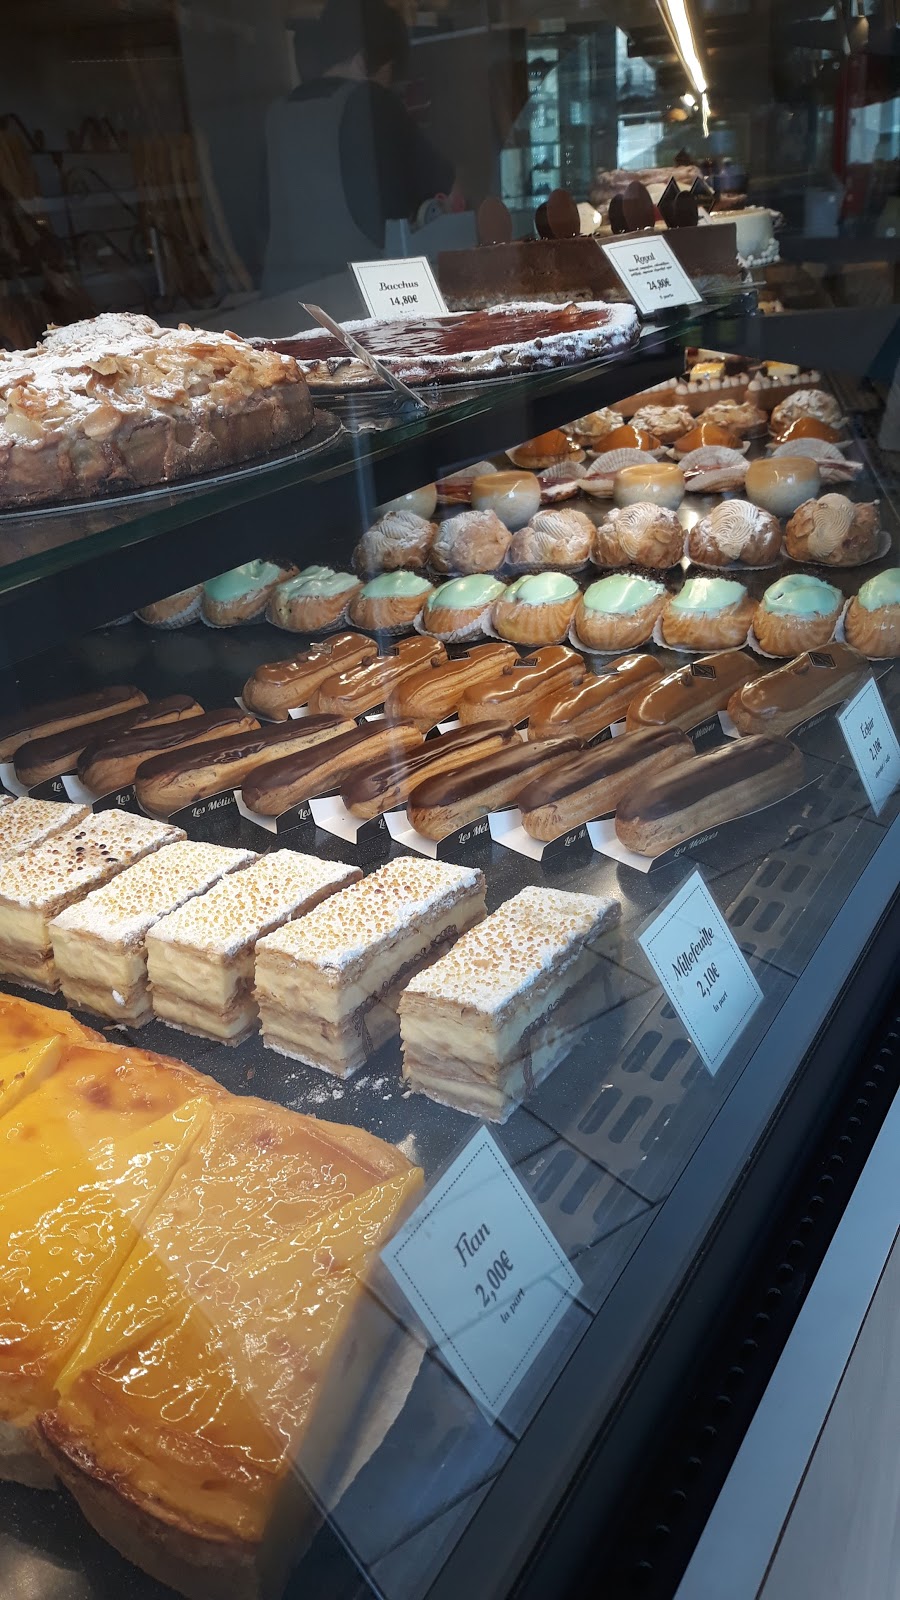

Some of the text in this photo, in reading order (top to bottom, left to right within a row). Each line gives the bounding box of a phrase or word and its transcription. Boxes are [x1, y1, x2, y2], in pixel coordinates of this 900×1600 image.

[633, 252, 656, 264] Royal
[379, 281, 419, 291] Bacchus
[647, 278, 672, 291] 24,80€
[390, 294, 418, 306] 14,80€
[116, 794, 131, 806] Les
[191, 806, 206, 818] Les
[458, 832, 471, 844] Les
[564, 835, 576, 846] Les
[671, 927, 715, 981] Millefeuille
[696, 962, 720, 998] 2,10€
[713, 990, 728, 1013] la part
[454, 1223, 491, 1268] Flan
[475, 1249, 514, 1308] 2,00€
[500, 1287, 525, 1324] la part
